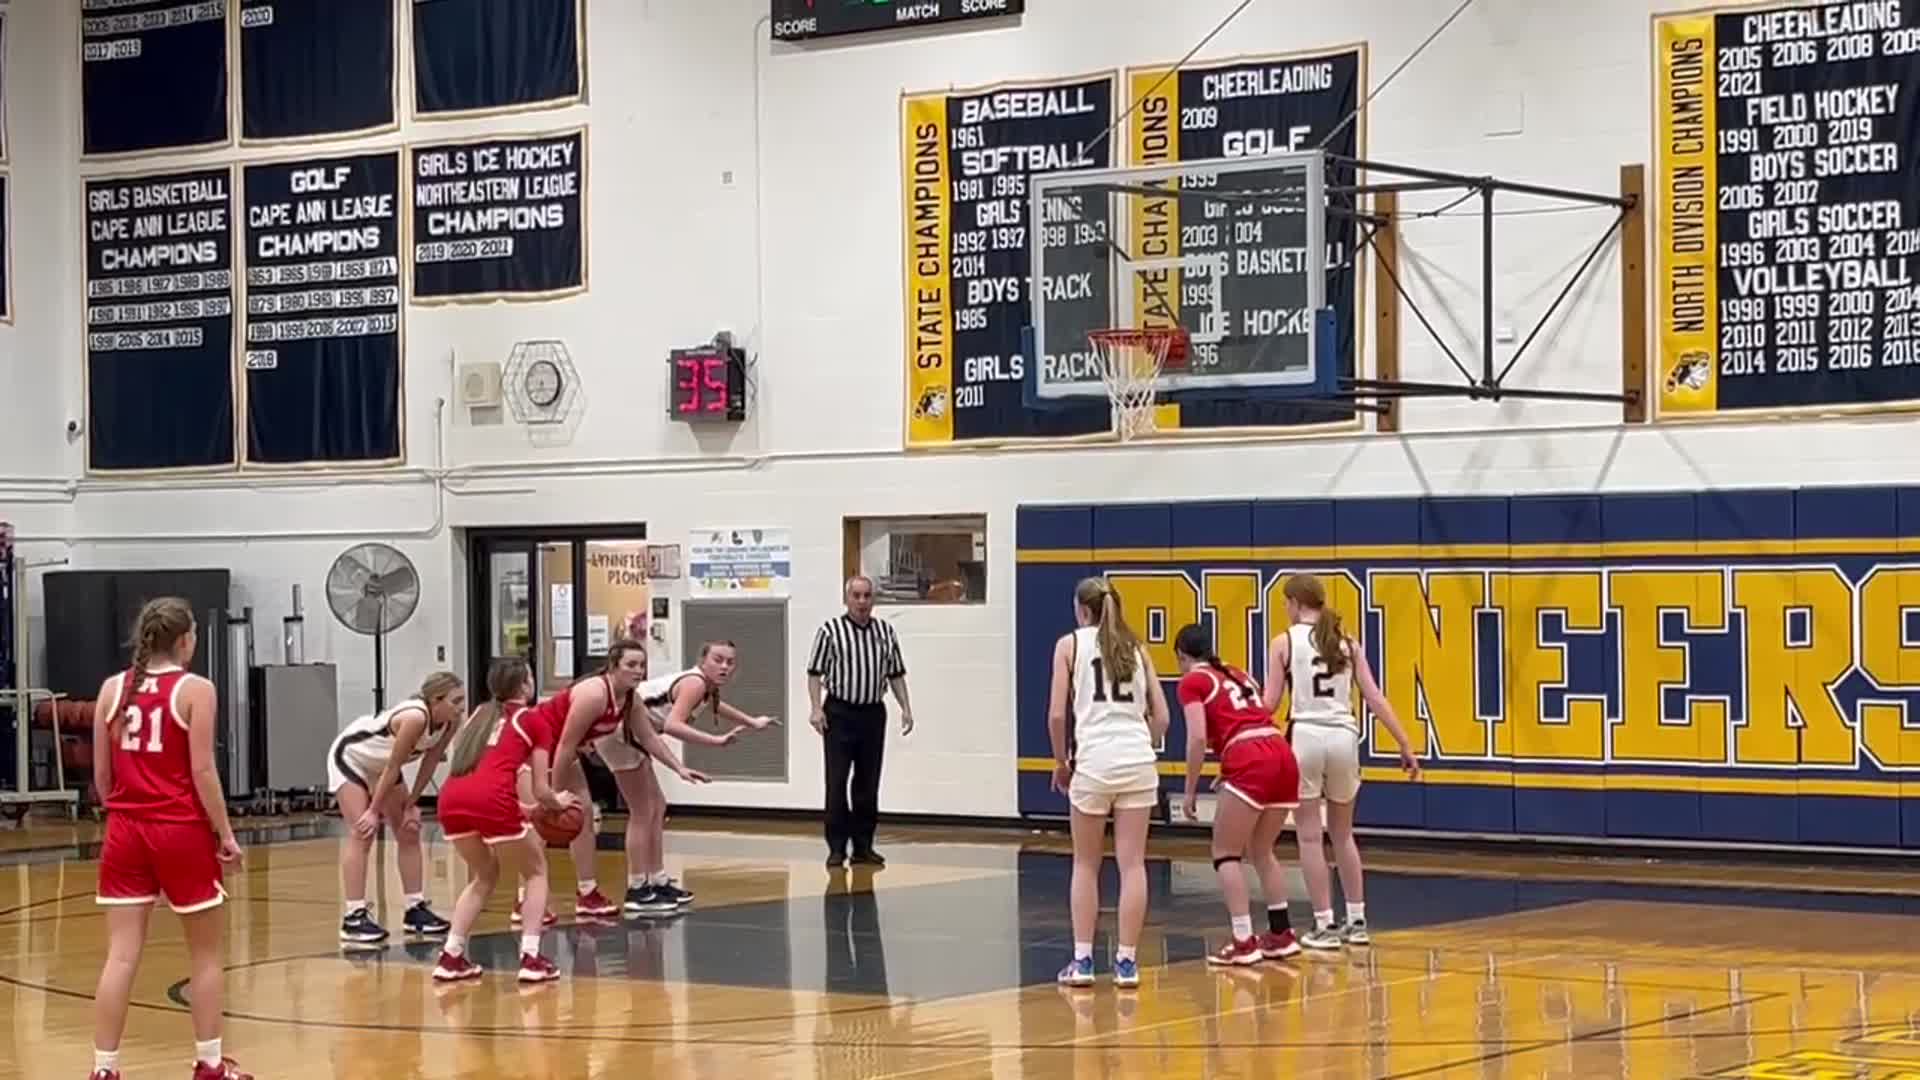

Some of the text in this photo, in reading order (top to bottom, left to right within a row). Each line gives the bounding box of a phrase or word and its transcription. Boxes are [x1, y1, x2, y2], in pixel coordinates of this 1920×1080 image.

[897, 4, 939, 20] MATCH
[961, 0, 1007, 13] SCORE
[774, 18, 817, 36] SCORE
[1743, 1, 1901, 44] CHEERLEADING
[1719, 46, 1762, 71] 2005
[1772, 41, 1816, 68] 2006
[1827, 35, 1873, 61] 2008
[1203, 63, 1332, 100] CHEERLEADING
[1719, 73, 1762, 98] 2021
[962, 88, 1094, 124] BASEBALL
[1182, 107, 1218, 129] 2009
[1747, 84, 1899, 125] FIELD HOCKEY
[952, 126, 984, 149] 1961
[1223, 125, 1311, 157] GOLF
[1719, 118, 1873, 154] 1991 2000 2019
[419, 142, 574, 176] GIRLS ICE HOCKEY
[962, 142, 1094, 175] SOFTBALL
[1751, 143, 1897, 182] BOYS SOCCER
[89, 179, 228, 212] GIRLS BASKETBALL
[291, 167, 351, 193] GOLF
[416, 172, 577, 207] NORTHEASTERN LEAGUE
[953, 179, 984, 202] 1981
[1671, 38, 1704, 332] NORTH DIVISION CHAMPIONS
[1719, 180, 1819, 210] 2006 2007
[91, 209, 226, 241] CAPE ANN LEAGUE
[250, 194, 393, 228] CAPE ANN LEAGUE
[428, 204, 563, 235] CHAMPIONS
[976, 200, 1021, 226] GIRLS
[1750, 201, 1901, 239] GIRLS SOCCER
[259, 226, 380, 257] CHAMPIONS
[914, 123, 942, 368] STATE CHAMPIONS
[953, 231, 986, 253] 1992
[992, 228, 1025, 250] 1997
[1182, 221, 1263, 248] 2003 004
[1721, 242, 1765, 267] 1996
[1775, 238, 1820, 264] 2003
[1829, 233, 1875, 259] 2004
[102, 241, 217, 269] CHAMPIONS
[953, 256, 985, 277] 2014
[968, 278, 1019, 305] BOYS
[1733, 258, 1912, 296] VOLLEYBALL
[955, 309, 987, 330] 1985
[1721, 298, 1765, 324] 1998
[1774, 294, 1820, 320] 1999
[1828, 291, 1873, 316] 2000
[1722, 324, 1766, 349] 2010
[1775, 321, 1816, 347] 2011
[1828, 318, 1873, 343] 2012
[964, 352, 1100, 382] GIRLS RACK
[1721, 351, 1766, 375] 2014
[1776, 347, 1819, 372] 2015
[1828, 344, 1872, 369] 2016
[677, 359, 727, 411] 35
[955, 385, 984, 408] 2011
[120, 705, 163, 752] 21
